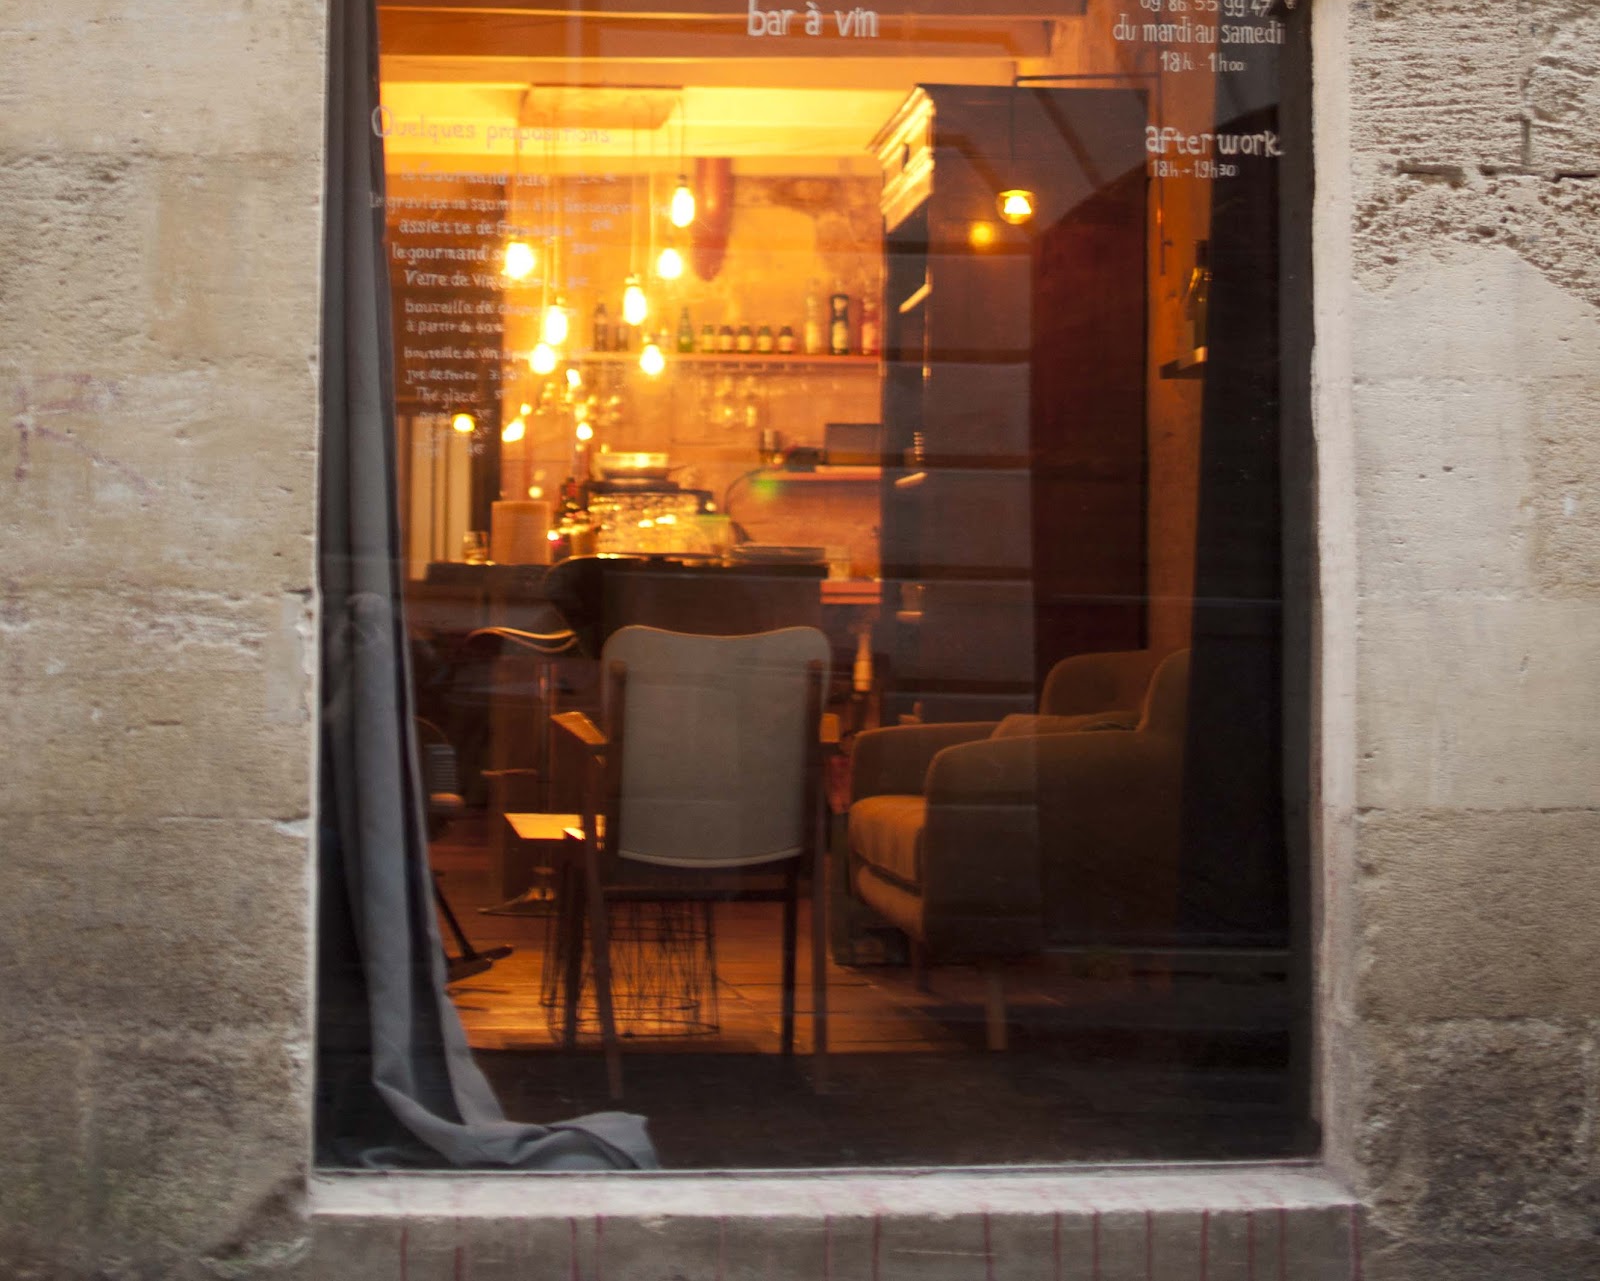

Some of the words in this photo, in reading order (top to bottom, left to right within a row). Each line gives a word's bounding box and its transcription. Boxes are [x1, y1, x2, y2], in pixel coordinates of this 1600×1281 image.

[804, 1, 823, 37] à
[834, 6, 879, 38] vin
[1112, 13, 1136, 41] du
[1143, 16, 1191, 43] mardi
[1195, 24, 1216, 44] au
[1220, 20, 1286, 44] samedi
[1160, 51, 1194, 72] 18h
[371, 105, 477, 144] Quelques
[485, 123, 611, 151] propositions
[1145, 125, 1214, 155] after
[1217, 130, 1286, 157] work
[1152, 159, 1179, 177] 18h
[1193, 159, 1236, 178] 19h30
[404, 270, 447, 286] Verre
